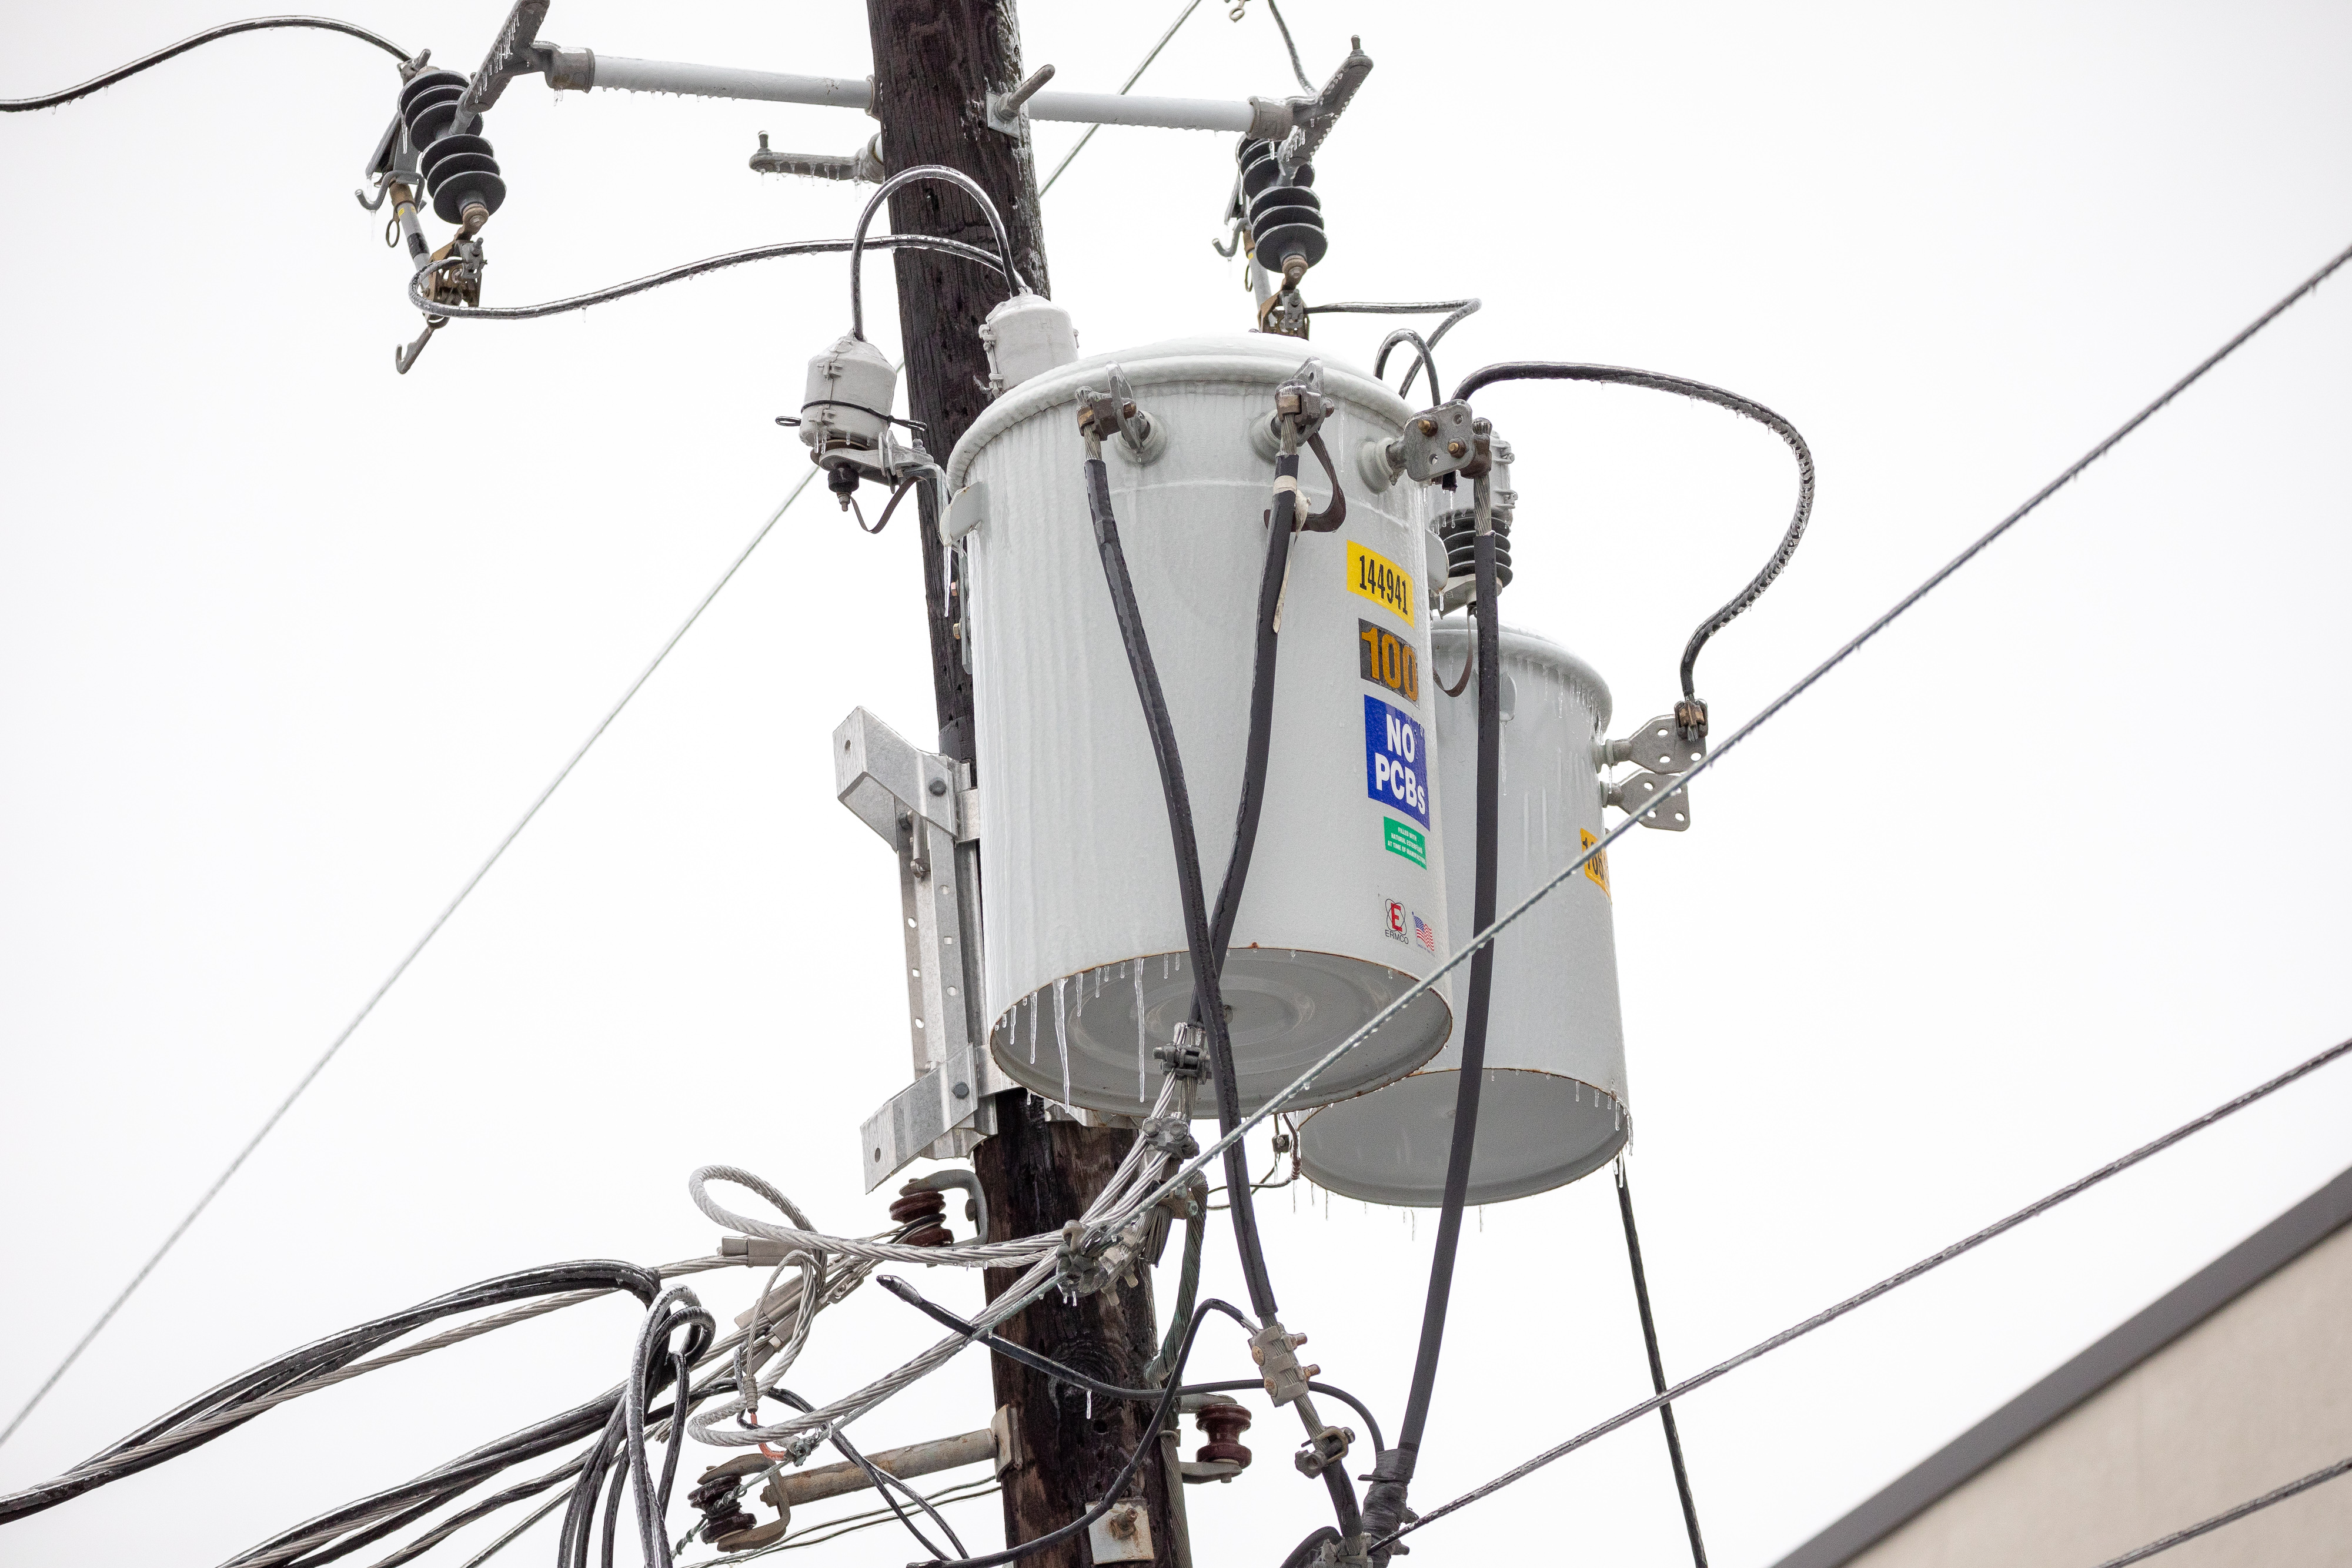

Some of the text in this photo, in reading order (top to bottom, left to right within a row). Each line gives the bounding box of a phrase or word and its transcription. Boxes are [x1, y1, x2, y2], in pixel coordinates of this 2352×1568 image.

[1359, 554, 1408, 616] 144941
[1361, 627, 1418, 701] 100
[1386, 713, 1415, 763] NO
[1375, 752, 1426, 815] PCBs
[1391, 833, 1406, 844] NATURAL
[1392, 842, 1401, 851] TIME
[1398, 827, 1417, 841] FILLED WITH
[1385, 929, 1409, 945] ERMCO
